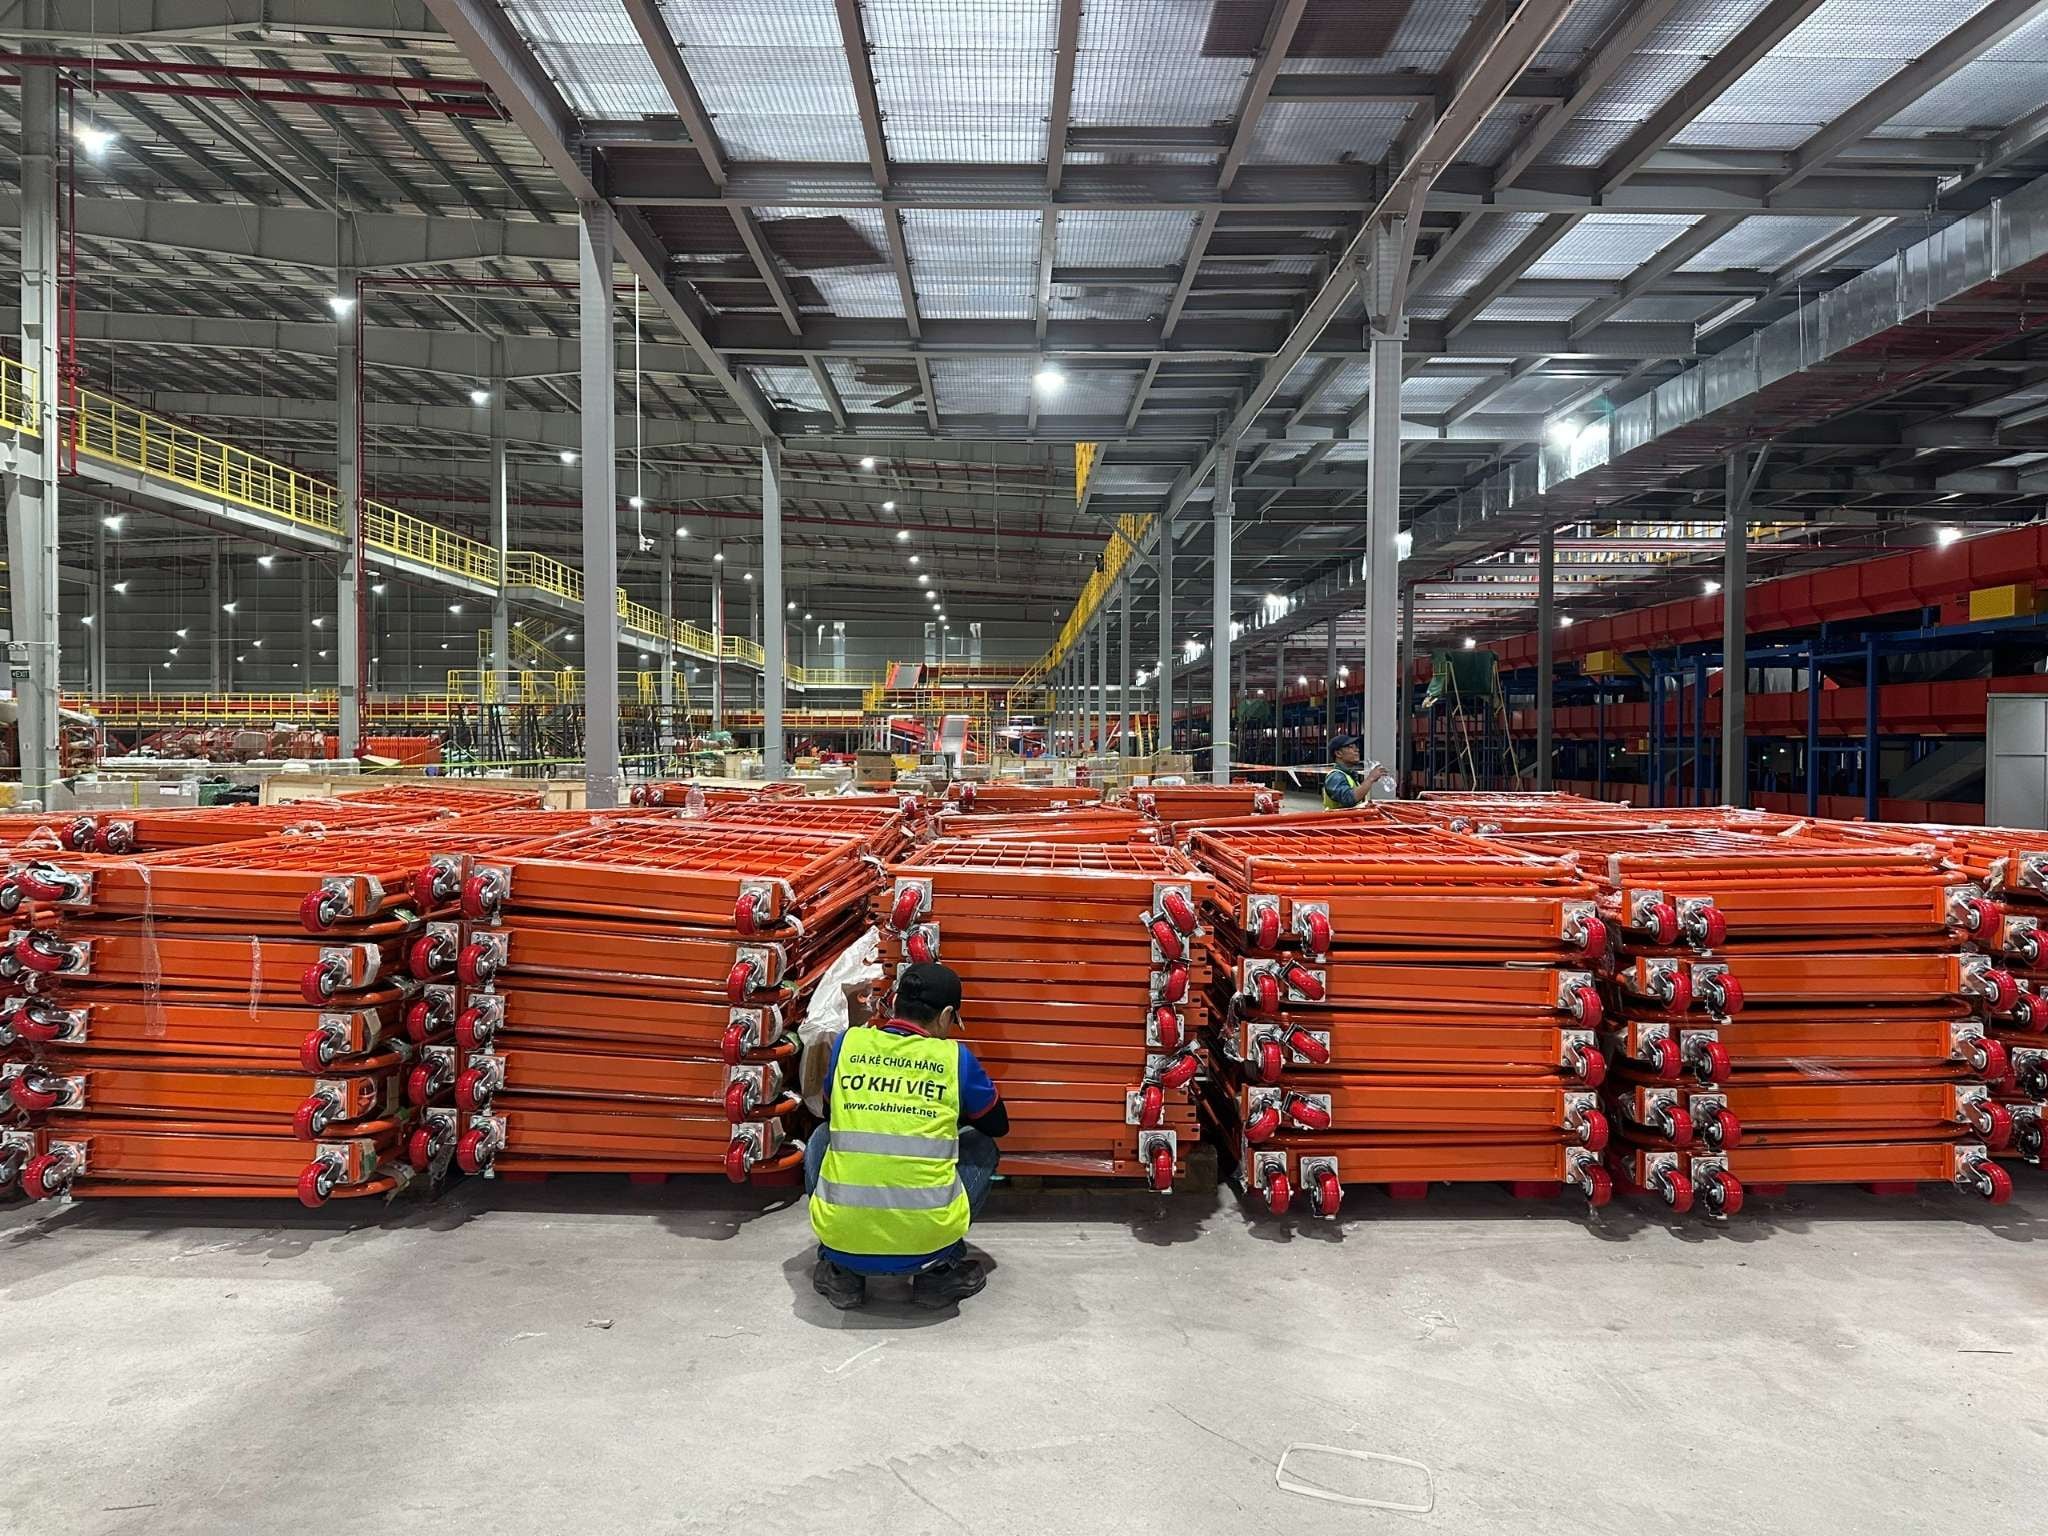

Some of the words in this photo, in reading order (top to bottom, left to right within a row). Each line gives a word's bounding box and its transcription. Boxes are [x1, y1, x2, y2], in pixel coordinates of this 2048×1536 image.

[850, 1053, 866, 1063] GIÁ
[883, 1056, 911, 1068] CHỨA
[914, 1059, 944, 1073] HÀNG
[841, 1073, 866, 1090] CƠ
[868, 1076, 903, 1093] KHÍ
[906, 1079, 947, 1101] VIỆT
[843, 1102, 937, 1118] www.cokhiviet.net
